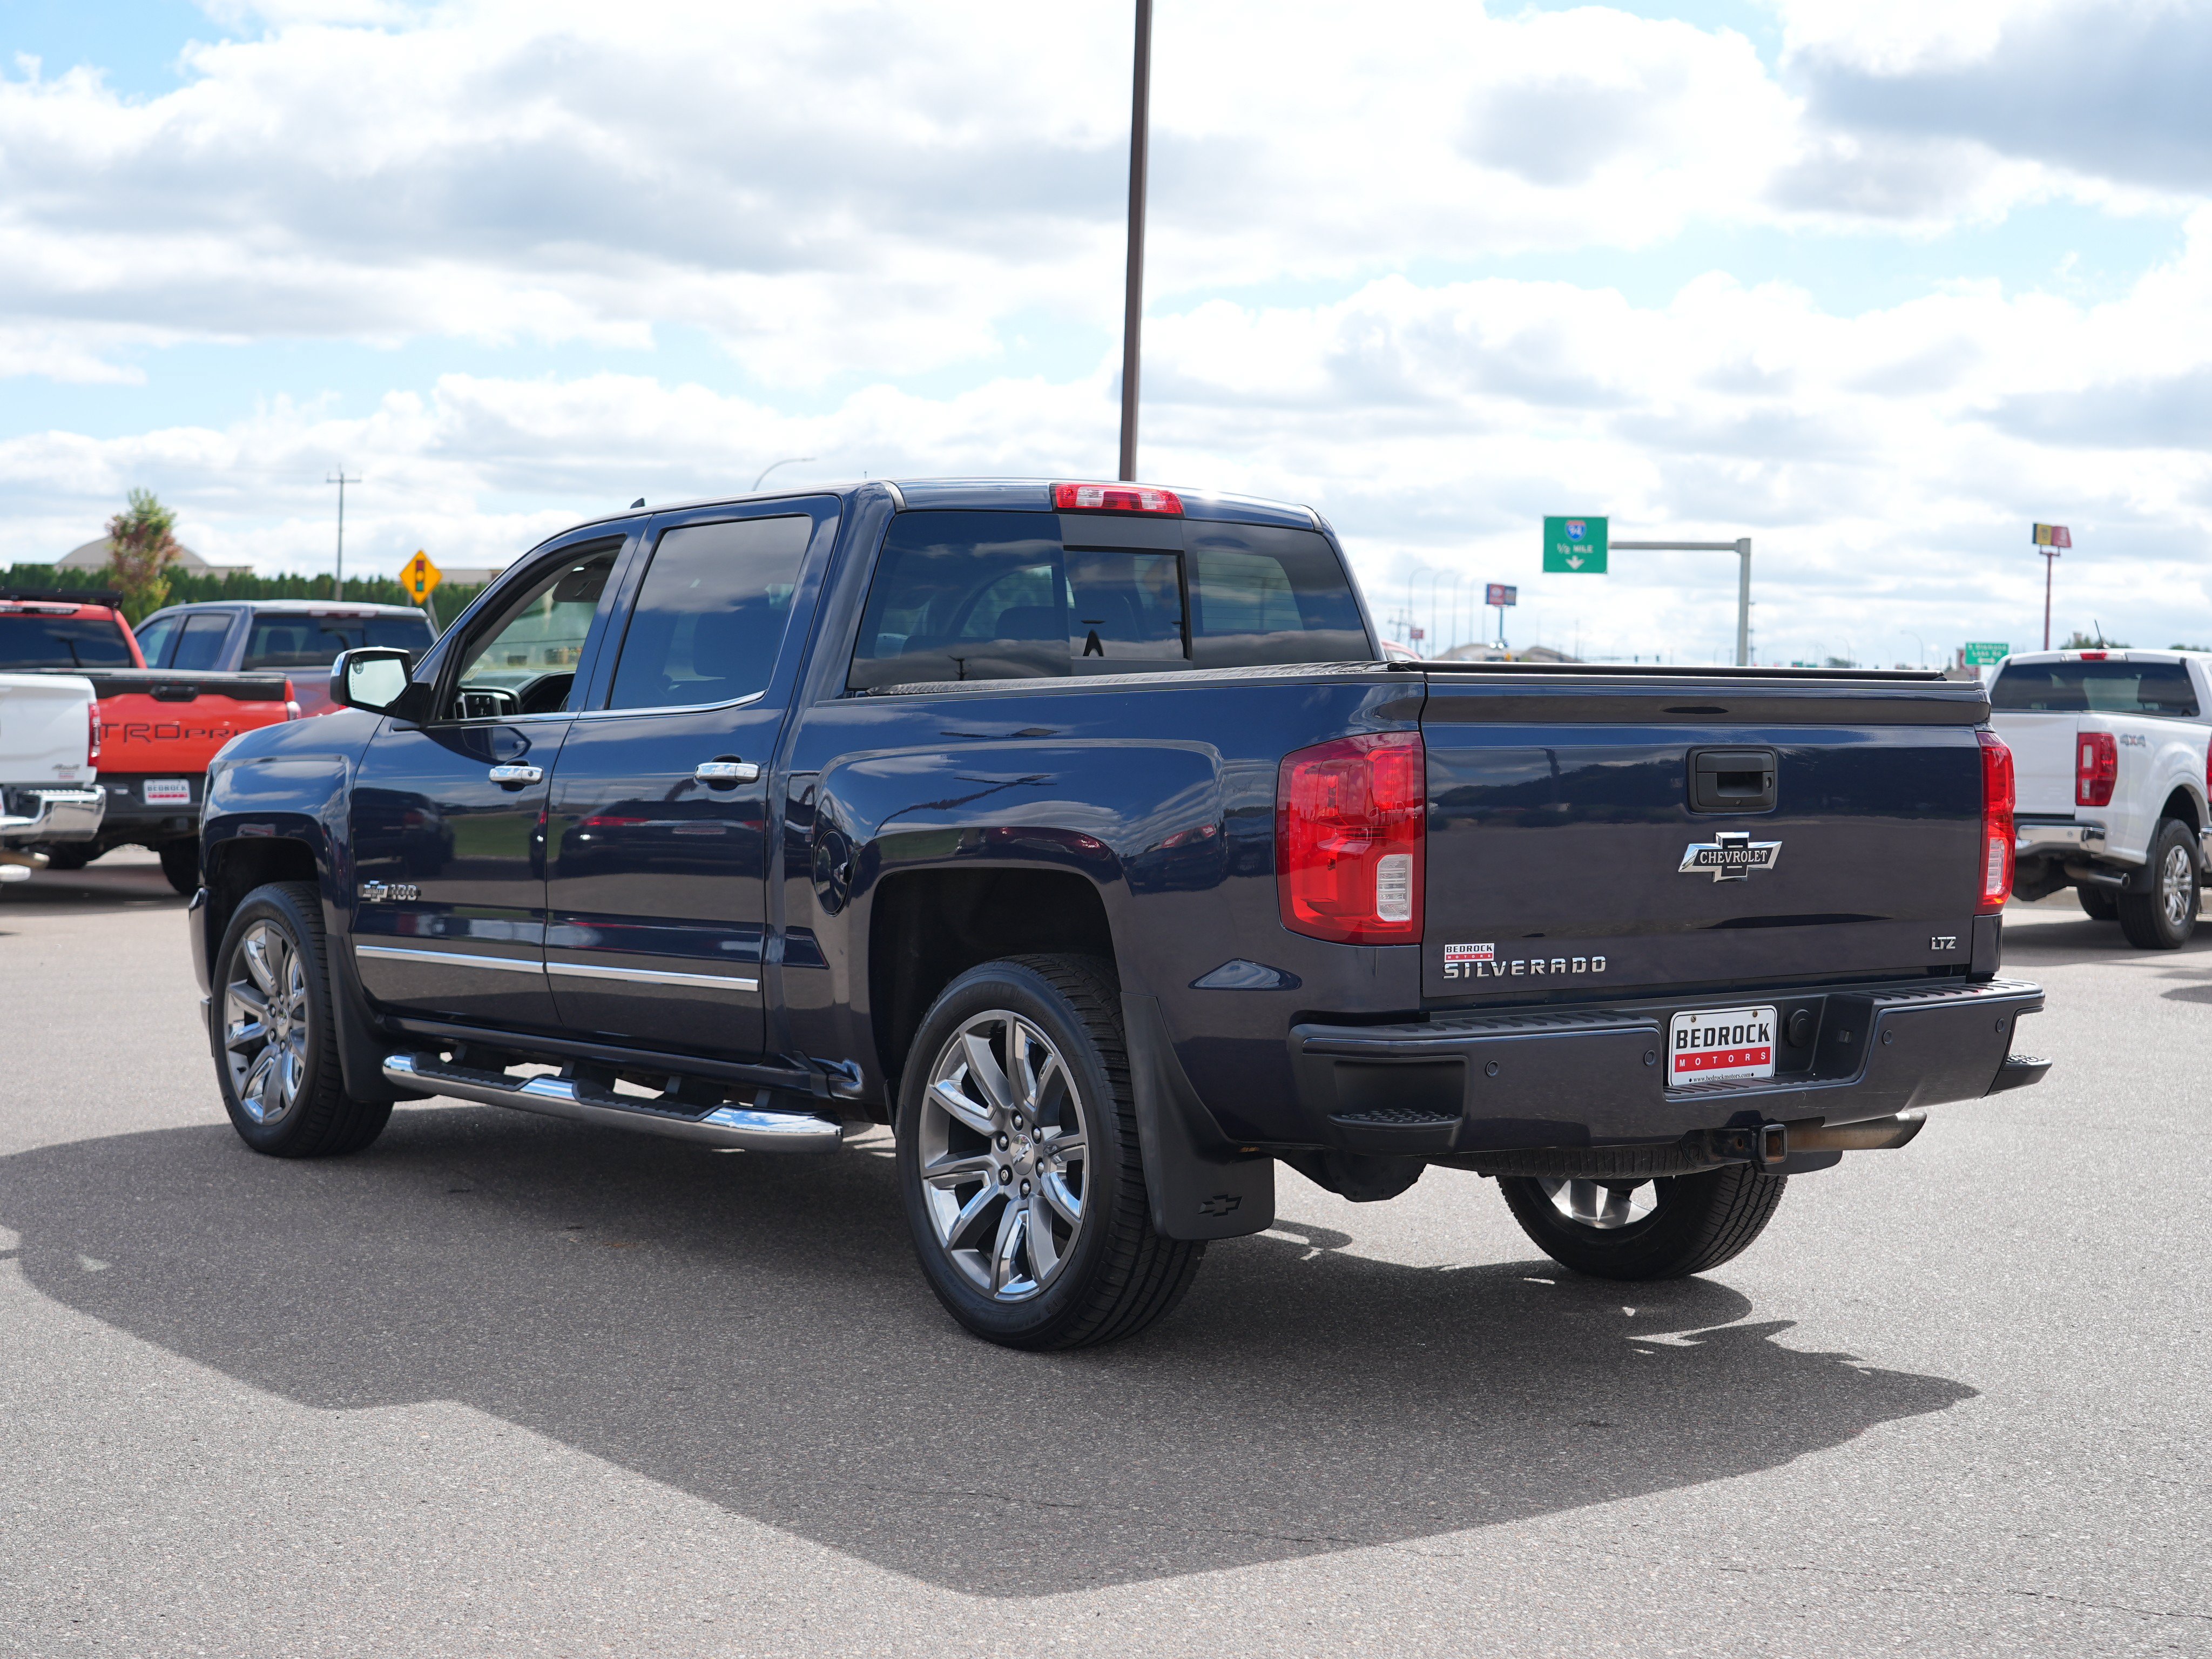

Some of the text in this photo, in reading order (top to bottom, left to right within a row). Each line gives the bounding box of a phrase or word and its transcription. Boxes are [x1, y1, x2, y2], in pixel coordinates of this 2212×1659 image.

[1568, 525, 1582, 535] 94
[1573, 544, 1594, 554] MILE
[101, 723, 180, 743] TRD
[1700, 850, 1768, 864] CHEVROLET
[1446, 944, 1493, 953] BEDROCK
[1931, 936, 1956, 950] LTZ
[1443, 956, 1606, 979] SILVERADO
[1676, 1023, 1770, 1049] BEDROCK
[1679, 1051, 1766, 1067] MOTORS
[1694, 1072, 1751, 1083] www.bedrockmotors.com
